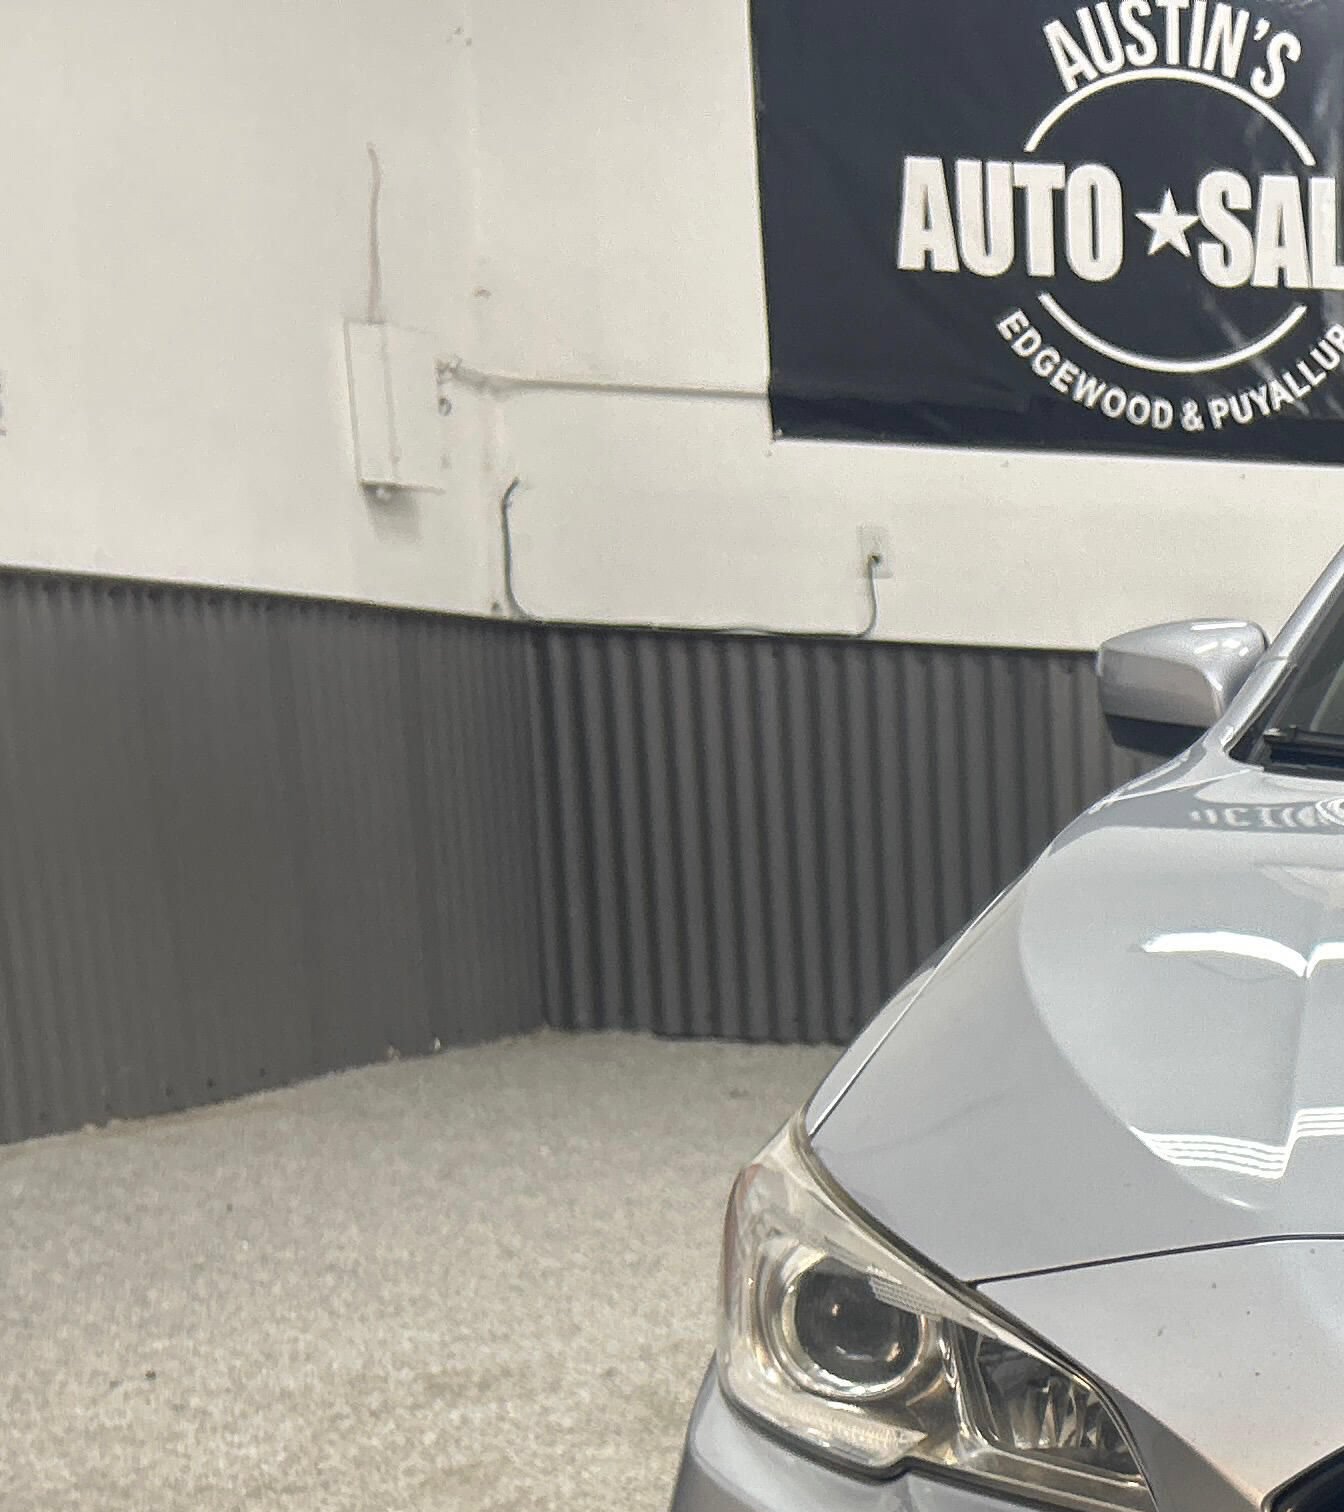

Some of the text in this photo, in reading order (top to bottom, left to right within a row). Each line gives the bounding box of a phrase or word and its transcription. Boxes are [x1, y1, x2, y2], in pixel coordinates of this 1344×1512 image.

[1043, 0, 1301, 98] AUSTIN'S
[897, 156, 1124, 282] AUTO
[997, 308, 1173, 430] EDGEWOOD
[1180, 398, 1204, 431] &
